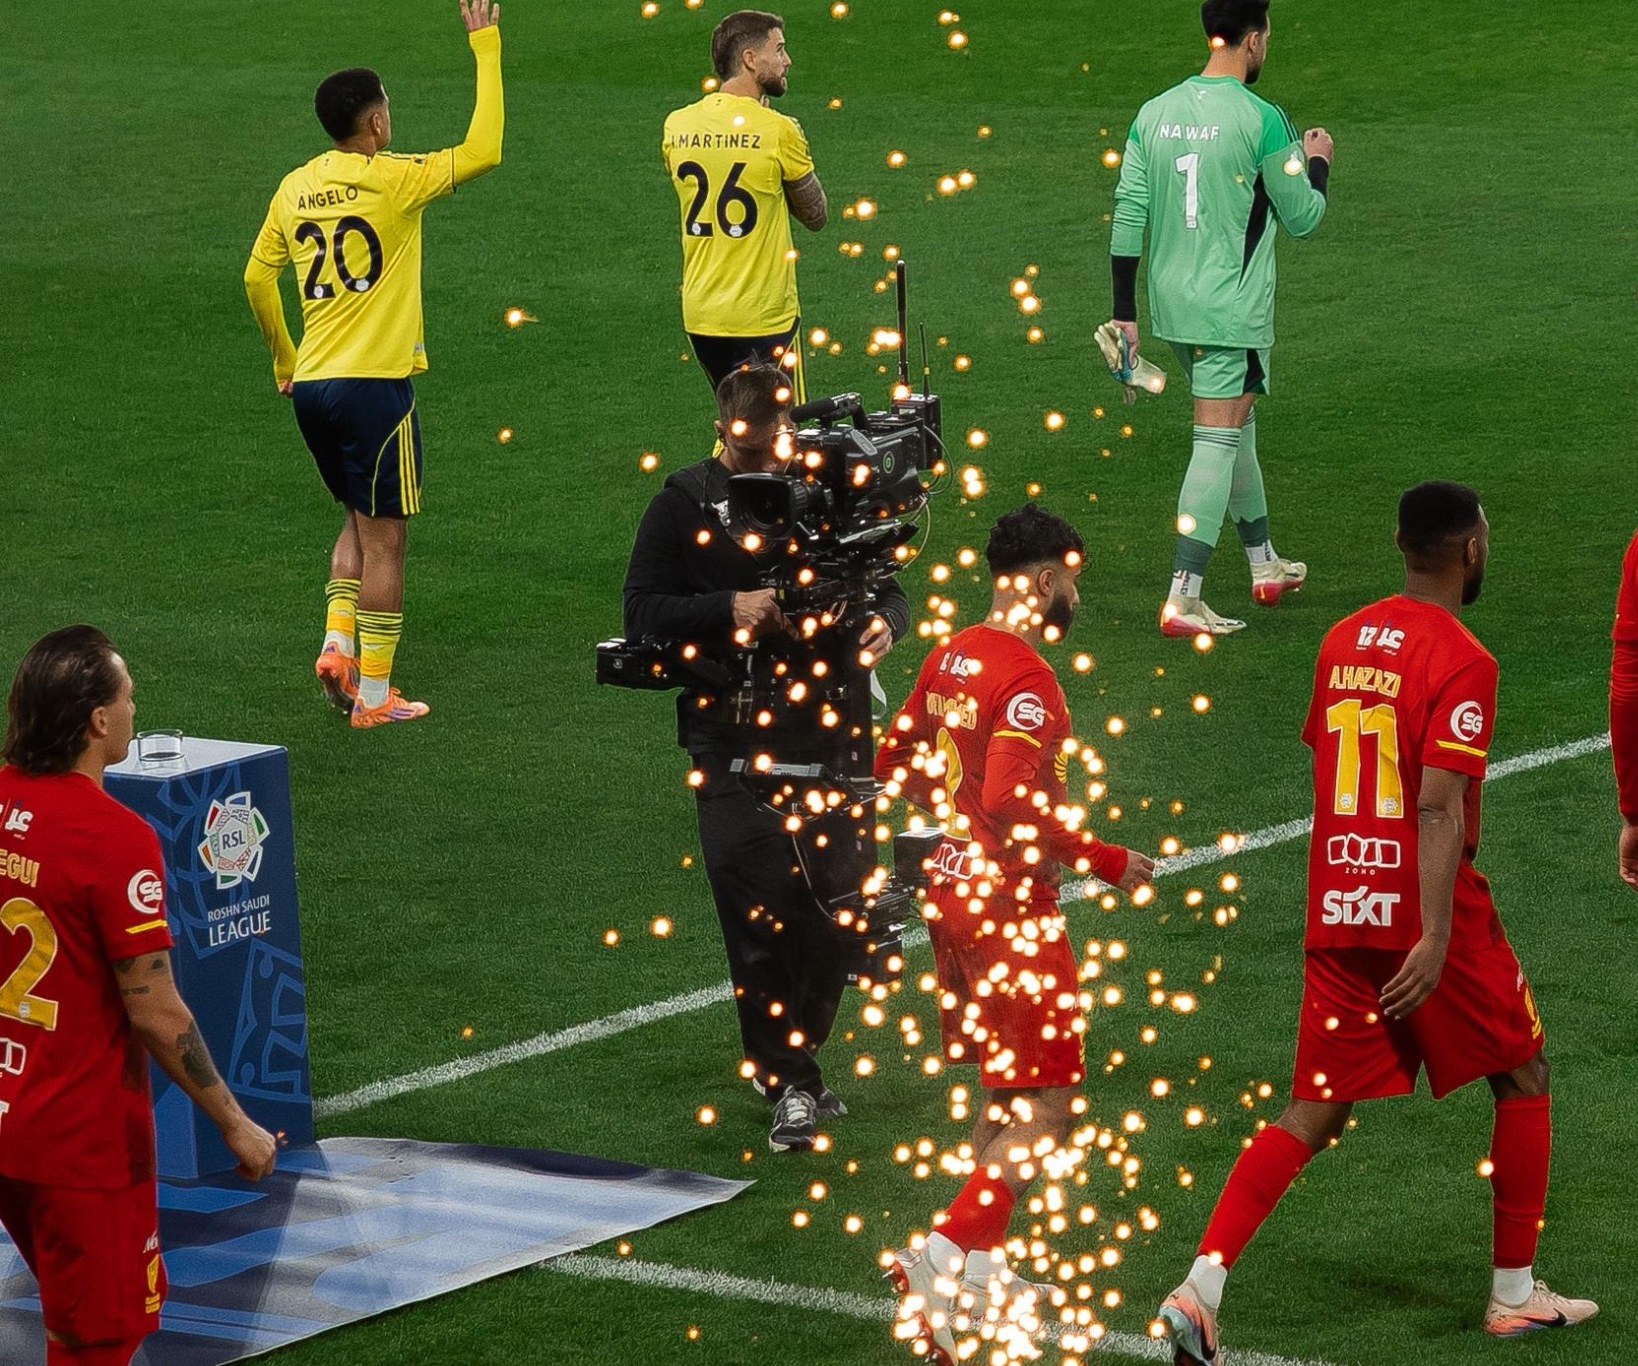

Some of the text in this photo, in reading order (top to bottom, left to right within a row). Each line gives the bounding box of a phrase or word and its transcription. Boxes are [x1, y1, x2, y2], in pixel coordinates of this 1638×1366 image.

[1159, 123, 1220, 141] NAWAF
[677, 160, 758, 238] 26
[1175, 151, 1199, 229] 1
[295, 215, 383, 300] 20
[1329, 665, 1402, 698] A.HAZAZI
[1326, 699, 1404, 819] 11
[222, 829, 246, 851] RSL
[208, 894, 270, 922] ROSHN SAUDI
[209, 910, 272, 946] LEAGUE
